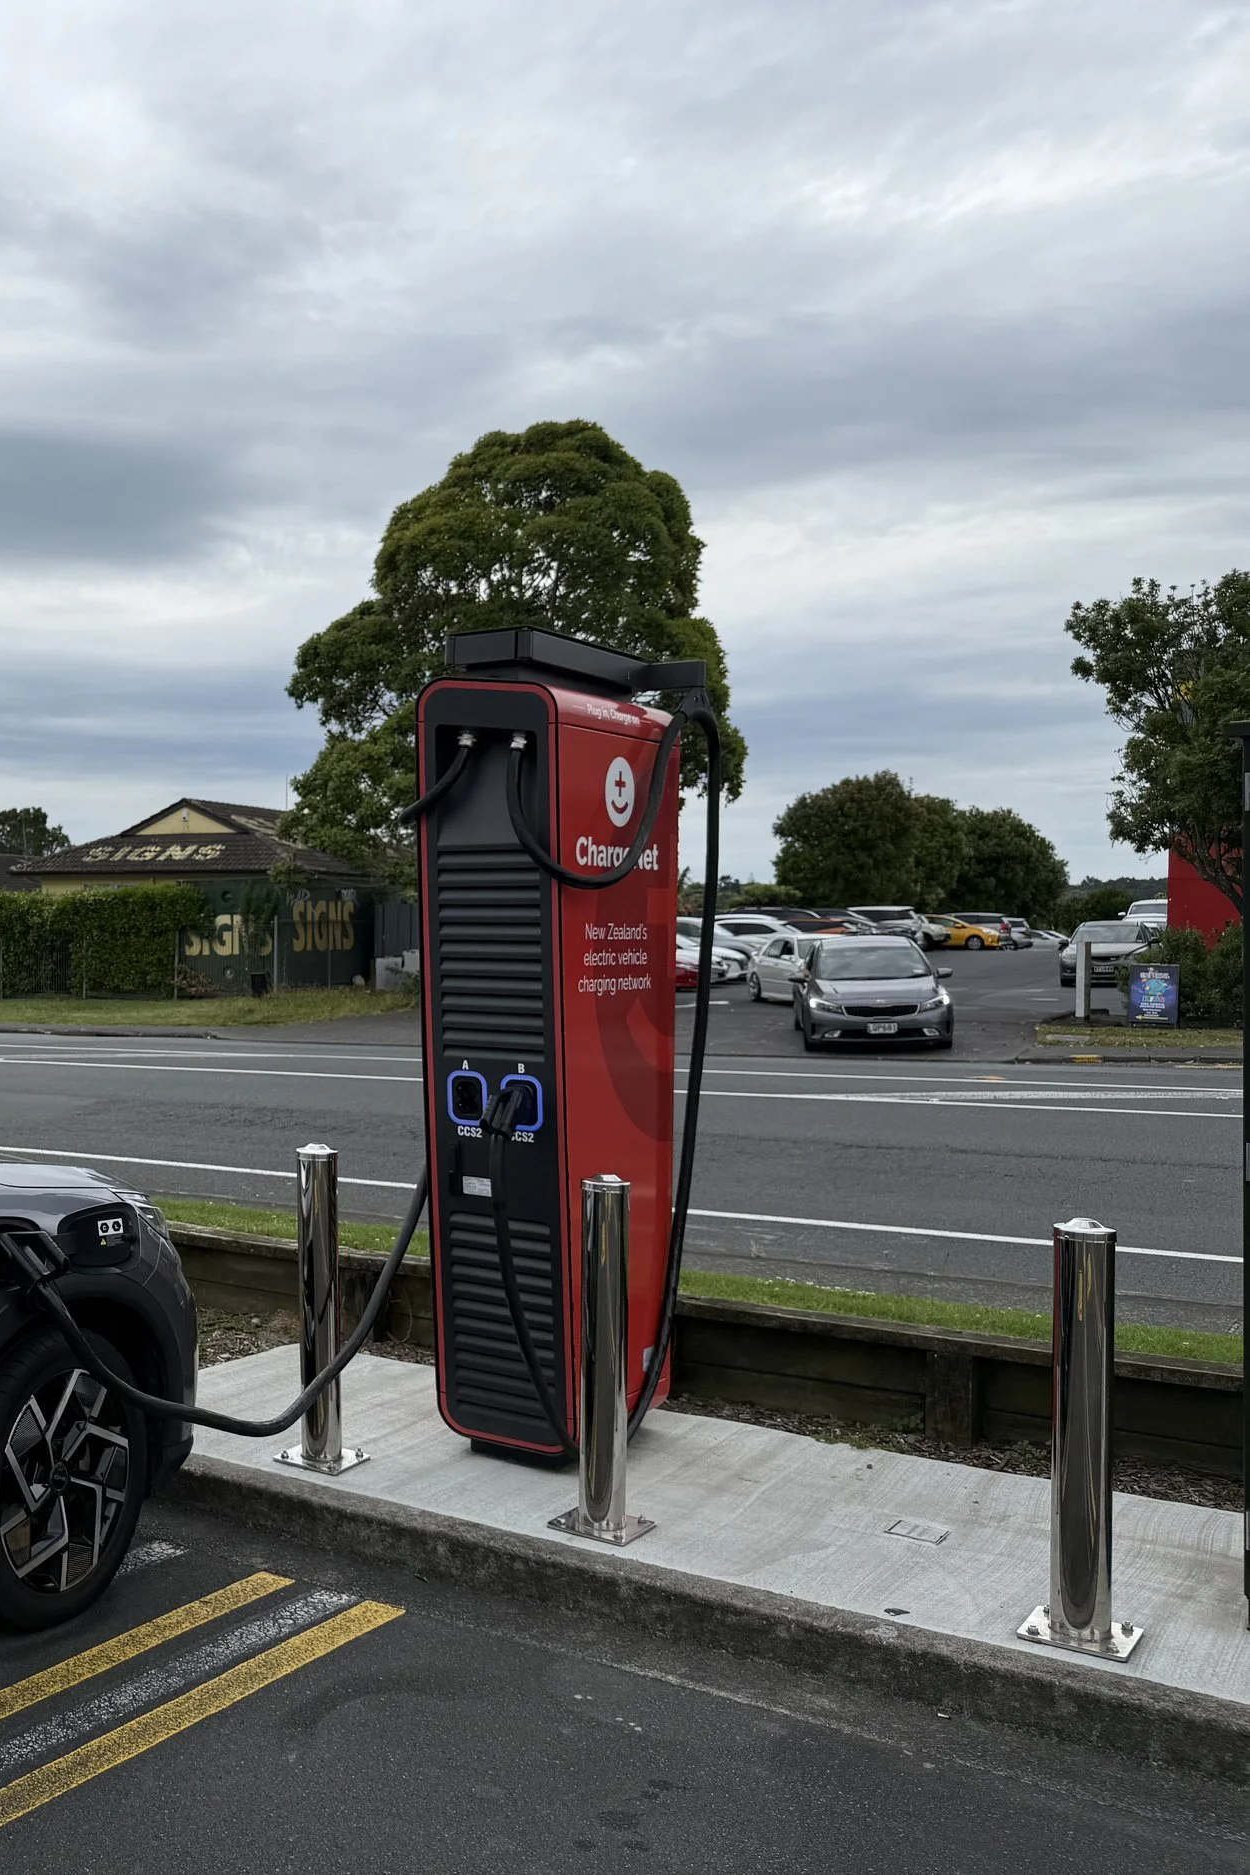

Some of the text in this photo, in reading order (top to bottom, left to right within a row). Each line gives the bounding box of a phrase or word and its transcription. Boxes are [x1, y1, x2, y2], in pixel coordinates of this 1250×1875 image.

[586, 703, 602, 720] Plug
[610, 708, 631, 726] Charge
[631, 715, 640, 725] on
[81, 843, 226, 863] SIGNS
[575, 836, 659, 871] Charget
[293, 899, 355, 952] SIGNS
[585, 922, 648, 940] New Zealand's
[583, 948, 648, 966] electric vehicle
[577, 973, 652, 997] charging network
[462, 1059, 470, 1070] A
[517, 1063, 525, 1074] B
[457, 1125, 483, 1139] CCS2
